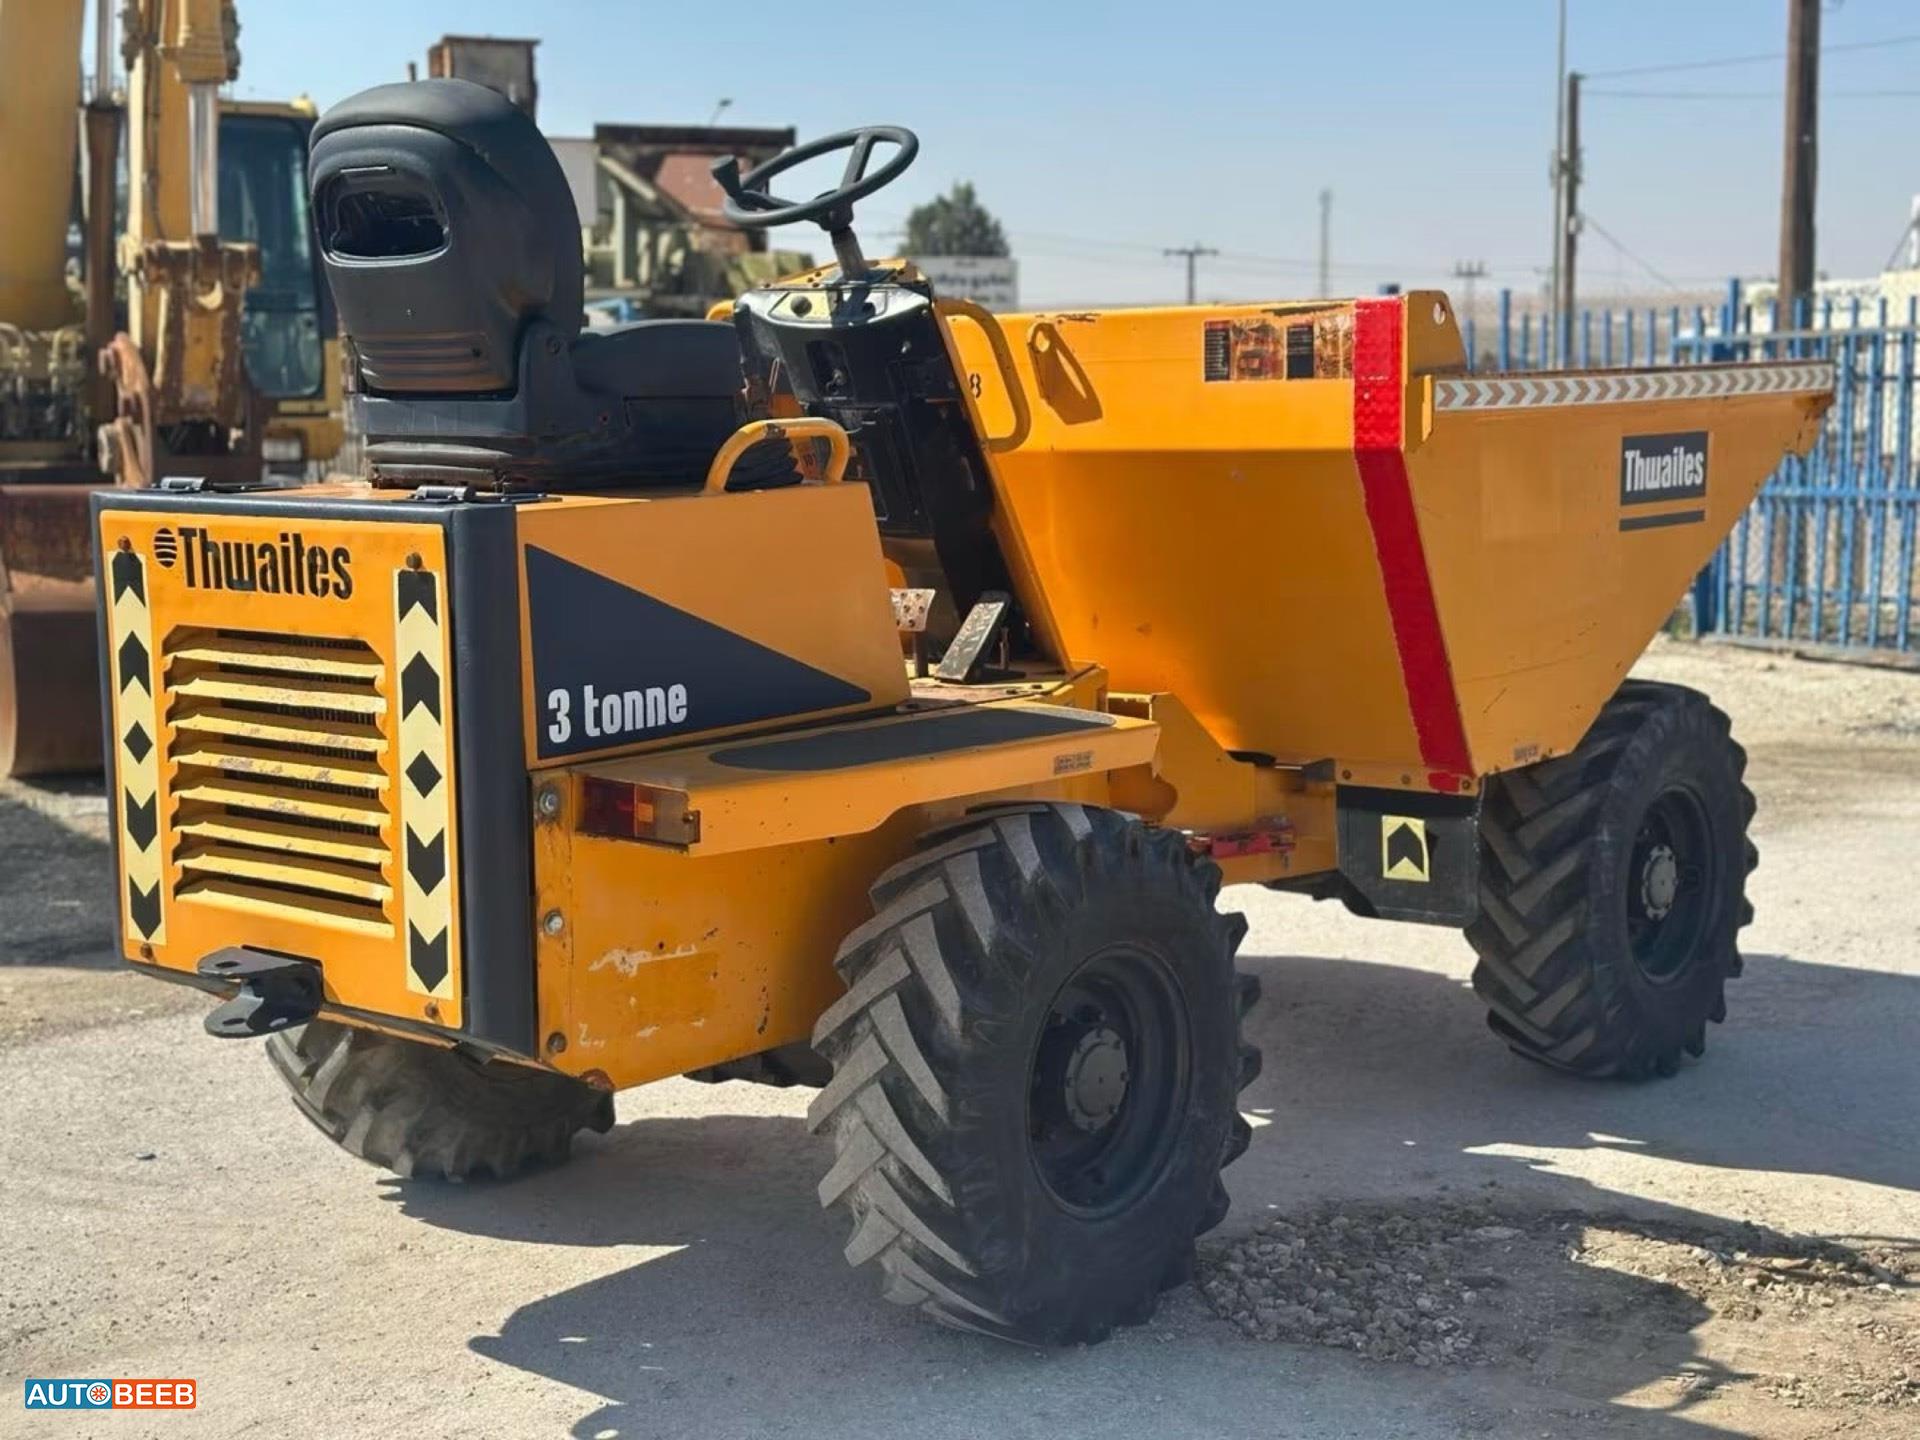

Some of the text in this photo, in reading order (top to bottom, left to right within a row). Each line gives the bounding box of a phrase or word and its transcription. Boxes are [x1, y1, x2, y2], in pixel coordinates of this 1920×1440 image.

[1624, 446, 1704, 492] Thwaites
[178, 528, 353, 600] Thwaites
[548, 683, 688, 743] 3 tonne
